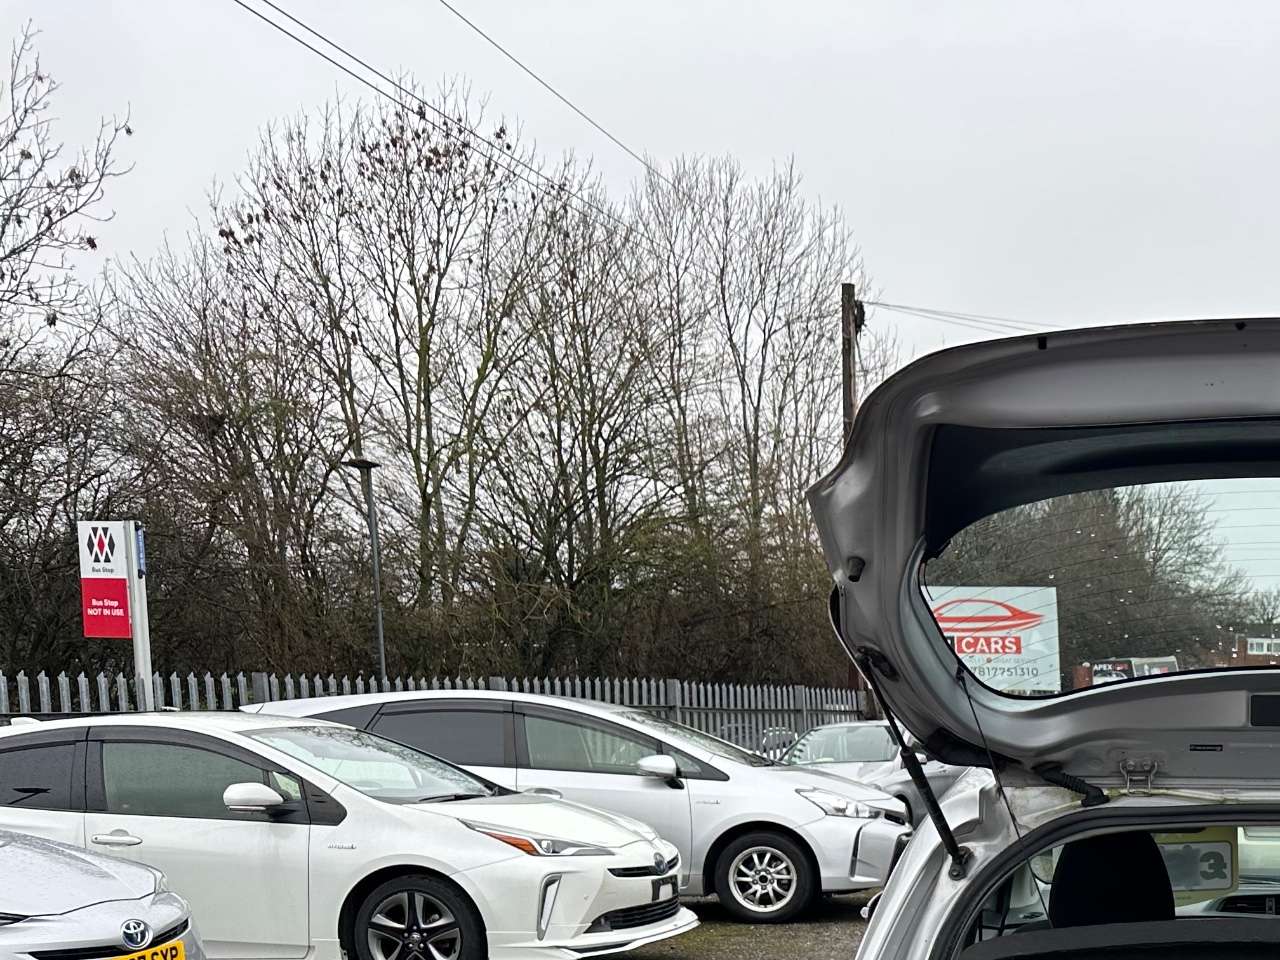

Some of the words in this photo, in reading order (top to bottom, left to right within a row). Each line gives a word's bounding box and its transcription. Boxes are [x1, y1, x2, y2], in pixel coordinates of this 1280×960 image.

[91, 598, 103, 606] Bus
[103, 598, 119, 608] Stop
[87, 608, 102, 616] NOT
[102, 608, 111, 616] IN
[111, 608, 125, 617] USE
[961, 637, 1017, 654] CARS
